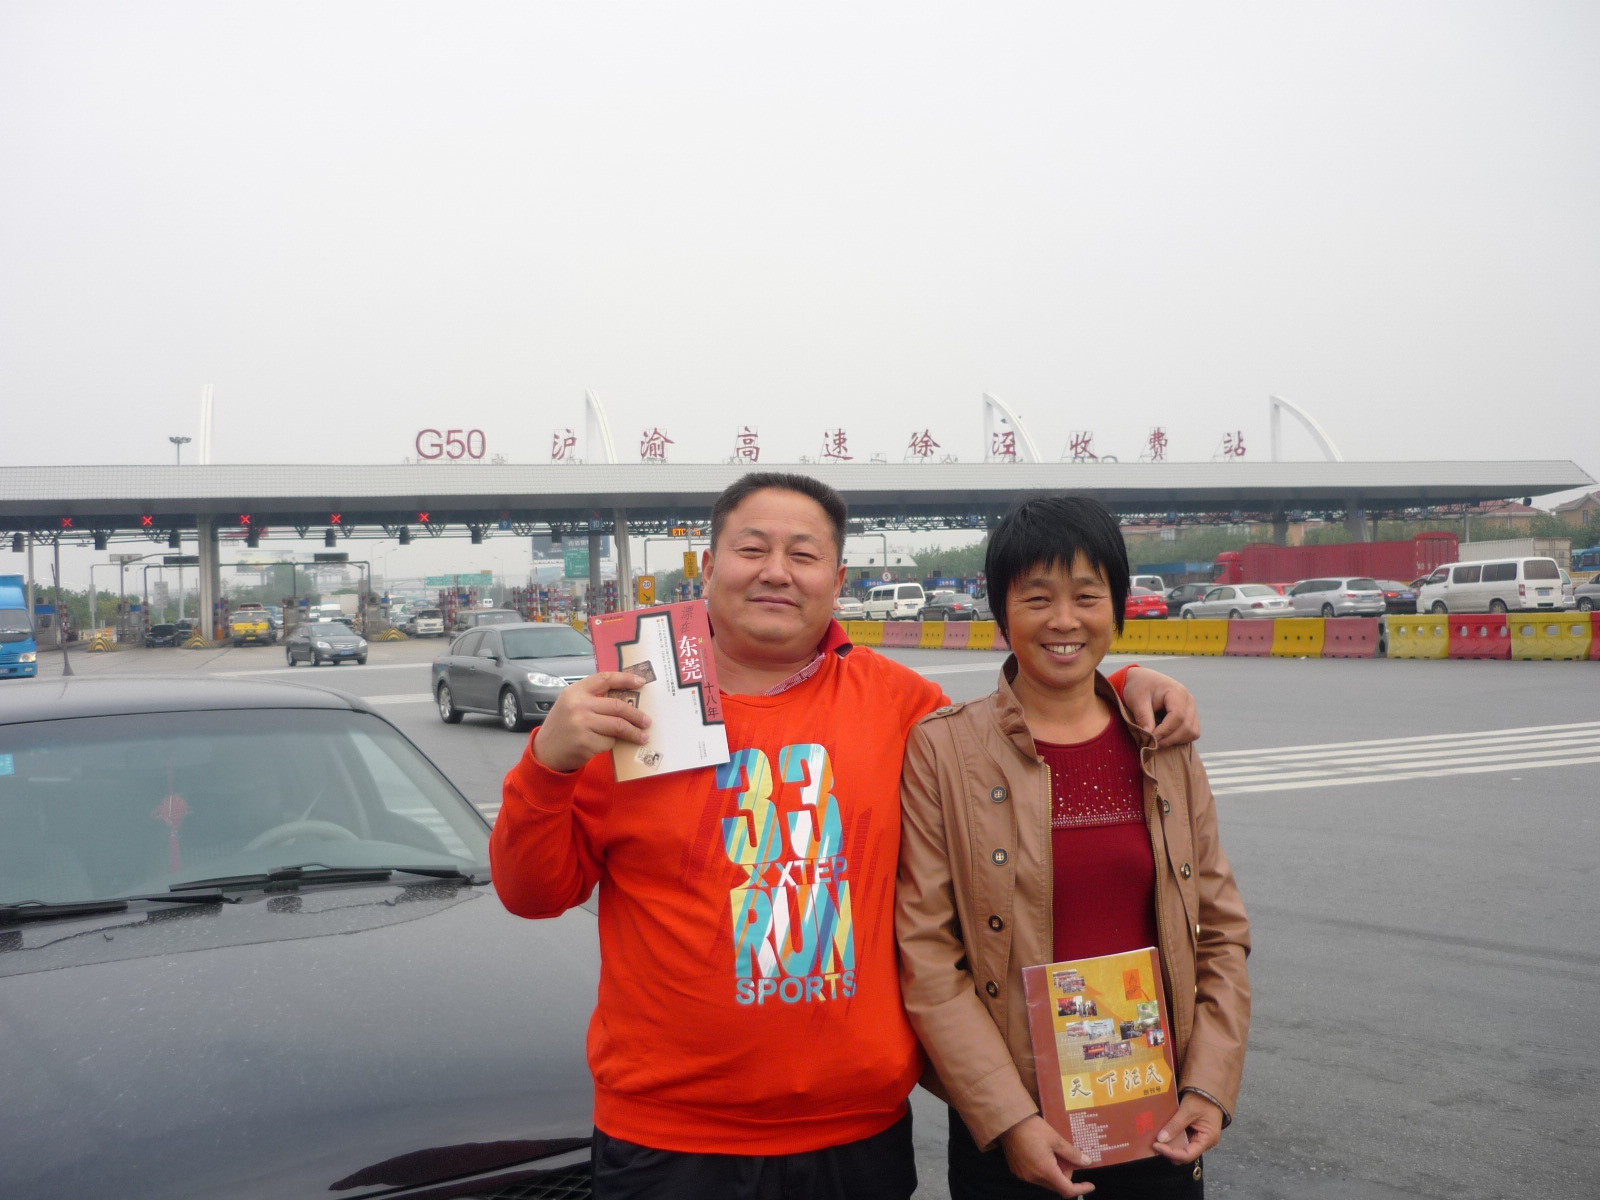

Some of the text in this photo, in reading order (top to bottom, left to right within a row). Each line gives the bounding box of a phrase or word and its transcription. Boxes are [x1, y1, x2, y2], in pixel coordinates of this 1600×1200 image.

[415, 428, 487, 460] G50
[593, 520, 600, 529] 10
[672, 527, 687, 536] ETC
[678, 634, 703, 682] 东莞
[704, 682, 719, 719] 十八年
[715, 743, 844, 865] 33
[729, 880, 856, 979] RUN
[735, 970, 858, 1006] SPORTS
